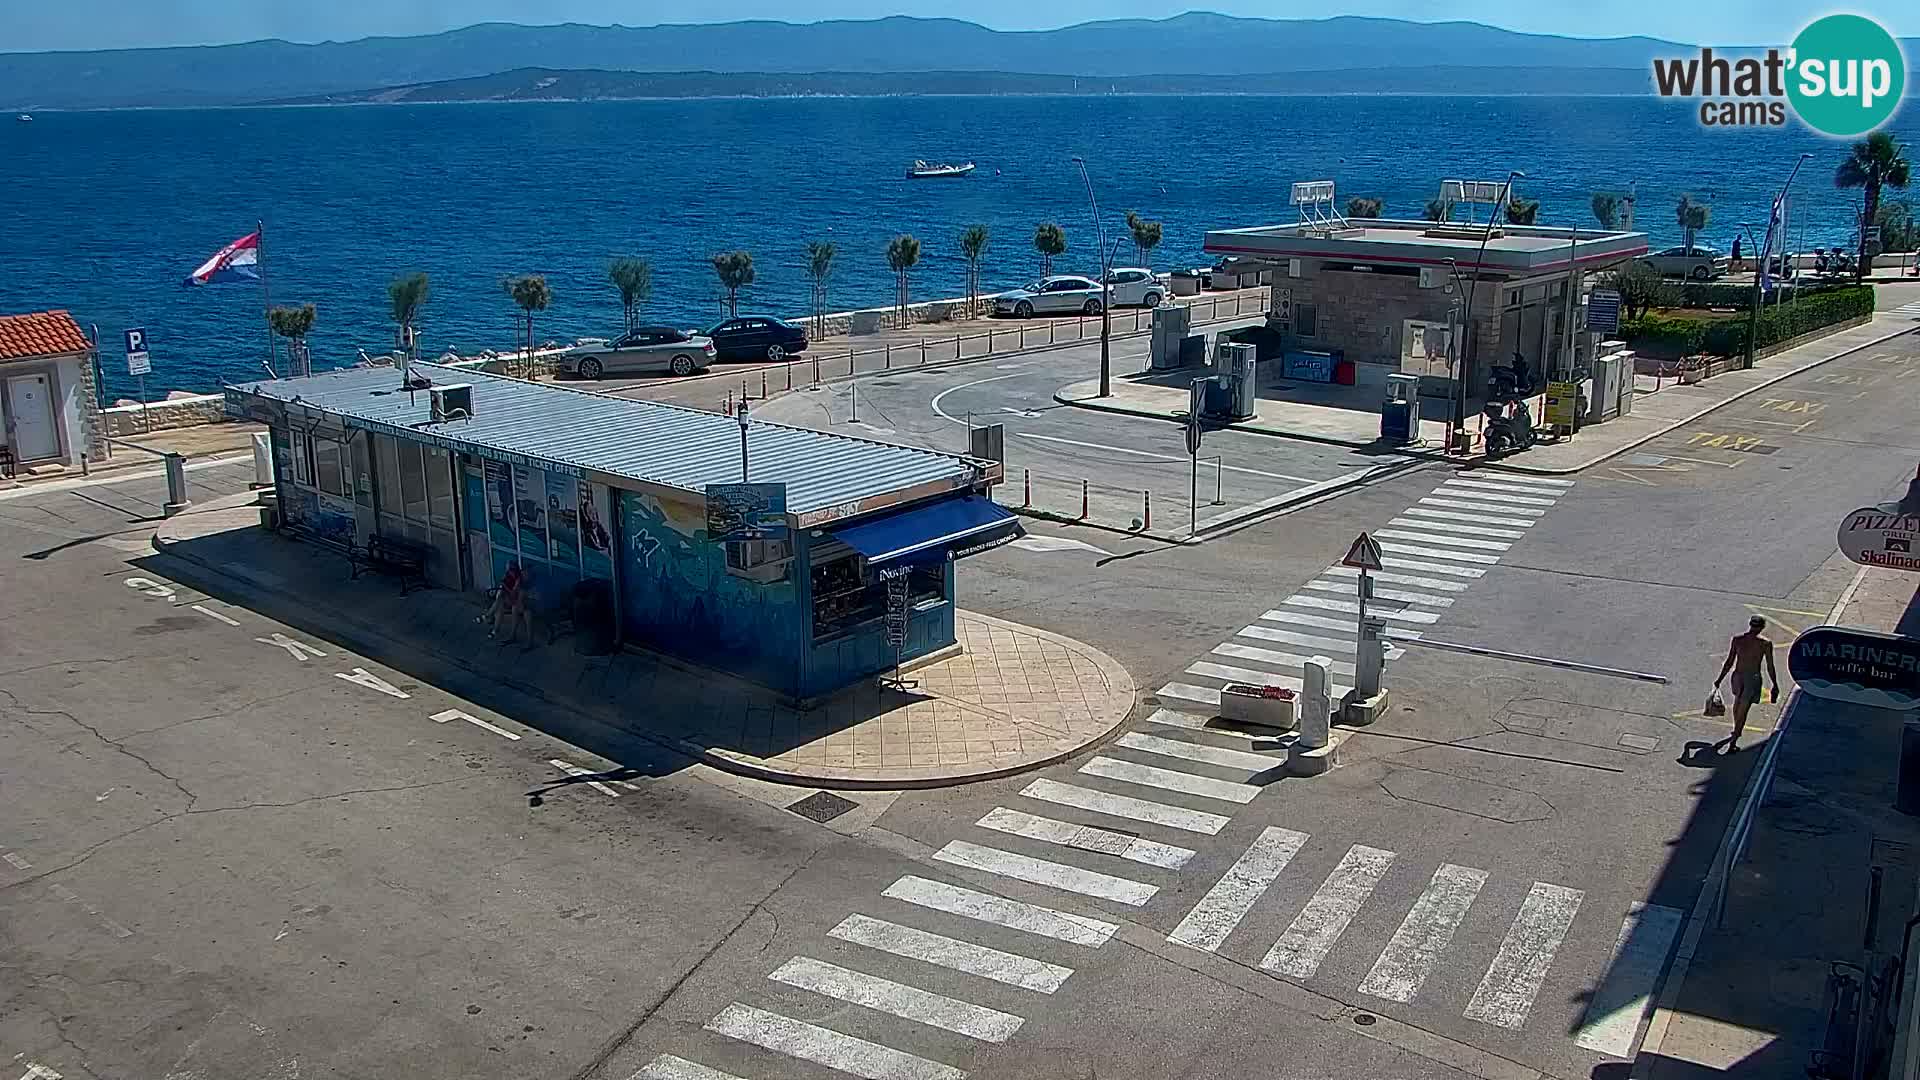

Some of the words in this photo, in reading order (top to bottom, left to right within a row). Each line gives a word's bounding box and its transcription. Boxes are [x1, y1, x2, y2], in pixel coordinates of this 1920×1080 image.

[1759, 398, 1828, 414] TAXI
[1686, 432, 1764, 451] TAXI
[494, 449, 526, 465] STATION
[528, 457, 554, 472] TICKET
[555, 464, 583, 478] OFFICE
[1849, 515, 1920, 533] PIZZE
[1871, 665, 1897, 680] bar
